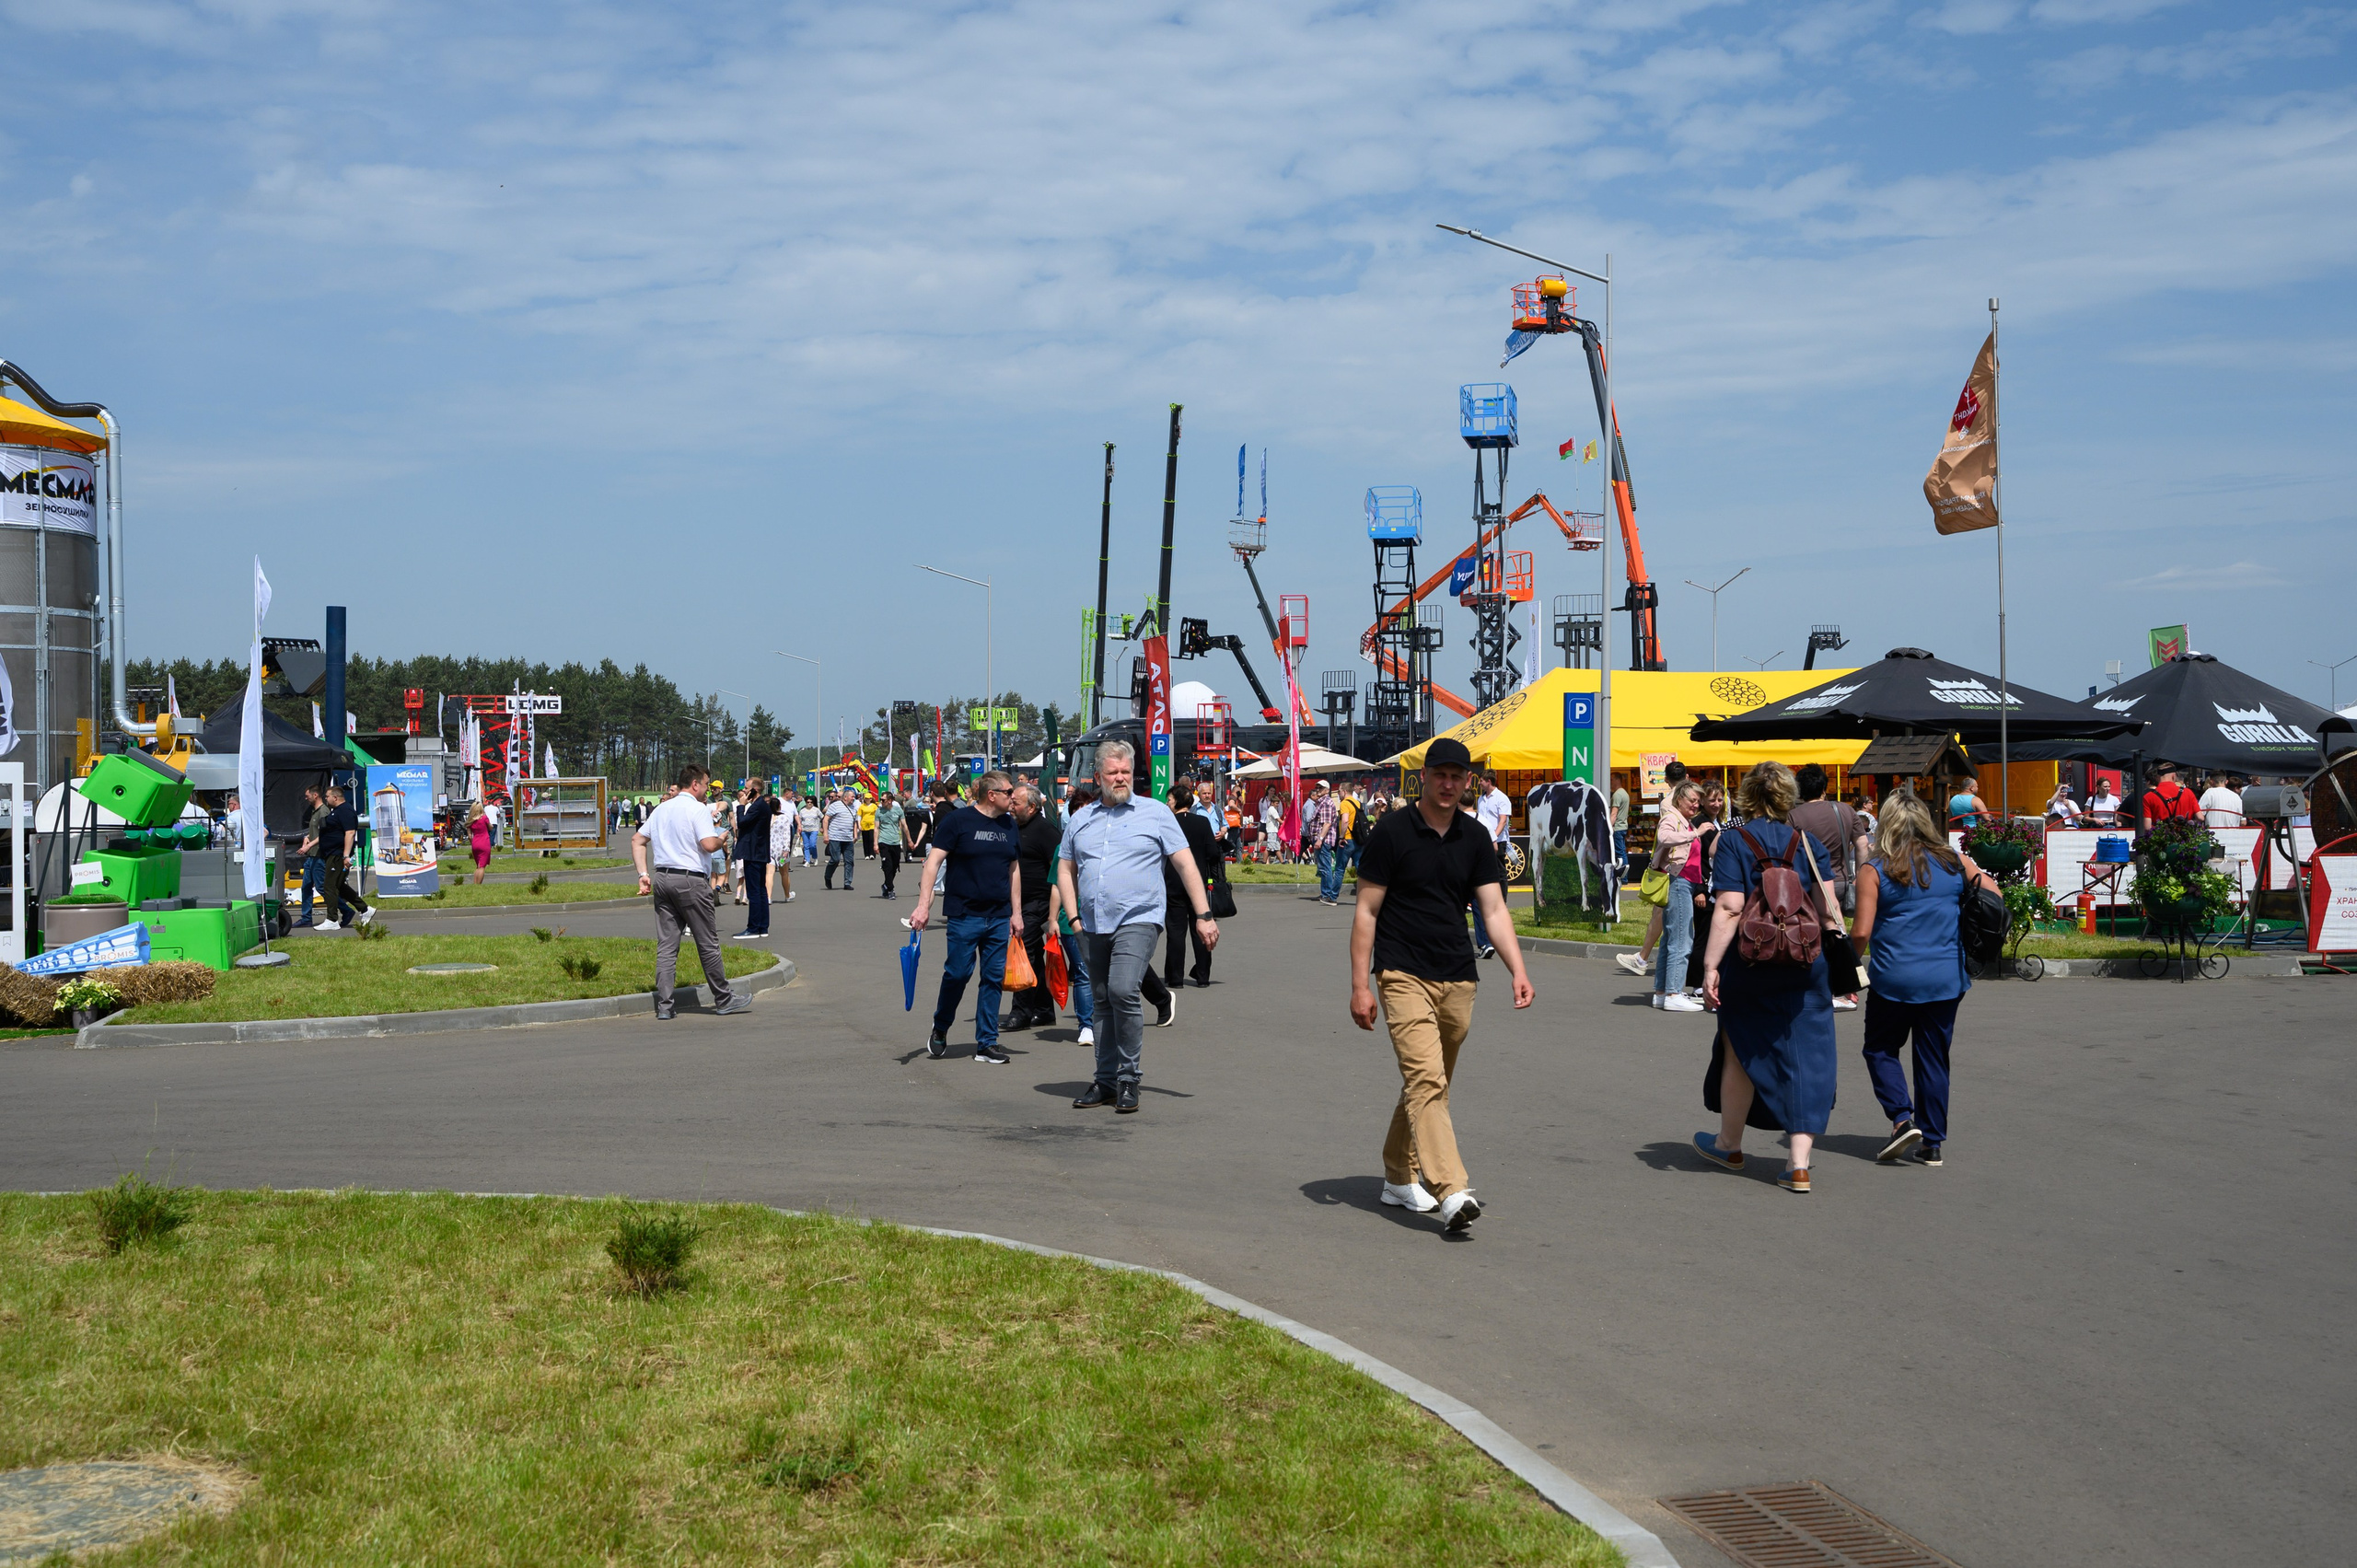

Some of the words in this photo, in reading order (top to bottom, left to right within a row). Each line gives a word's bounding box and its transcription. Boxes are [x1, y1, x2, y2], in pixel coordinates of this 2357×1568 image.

[0, 470, 95, 506] MECMAR
[1929, 690, 2025, 704] GORILLA
[1575, 703, 1587, 719] P
[2217, 724, 2319, 743] GORILLA
[1157, 739, 1165, 750] P
[1573, 747, 1587, 766] N
[1155, 765, 1166, 777] N
[1157, 784, 1164, 795] 7
[75, 869, 100, 877] PROMIS
[94, 950, 134, 961] PROMIS
